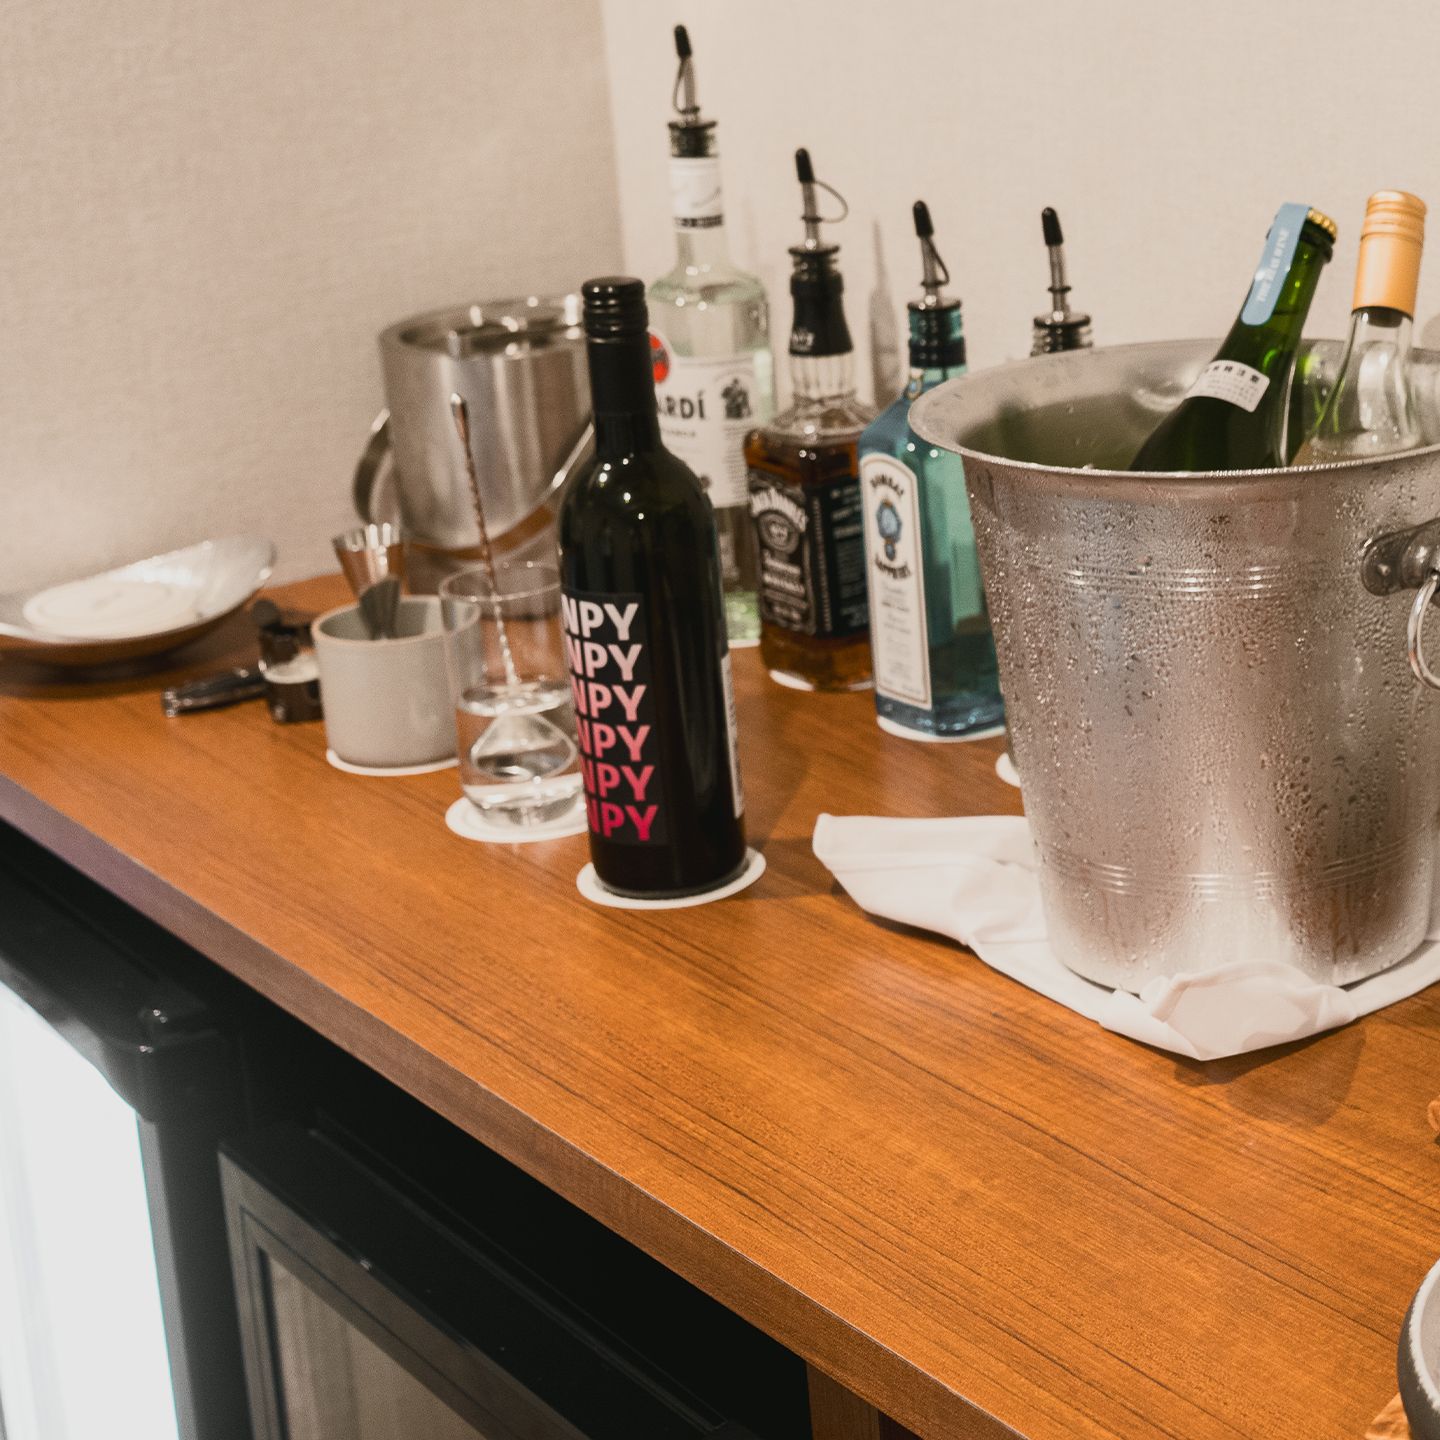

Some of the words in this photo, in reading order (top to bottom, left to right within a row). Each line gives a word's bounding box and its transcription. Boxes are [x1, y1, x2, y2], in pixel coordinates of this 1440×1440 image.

[561, 593, 639, 641] NPY
[566, 635, 643, 681] NPY
[571, 674, 647, 722] NPY
